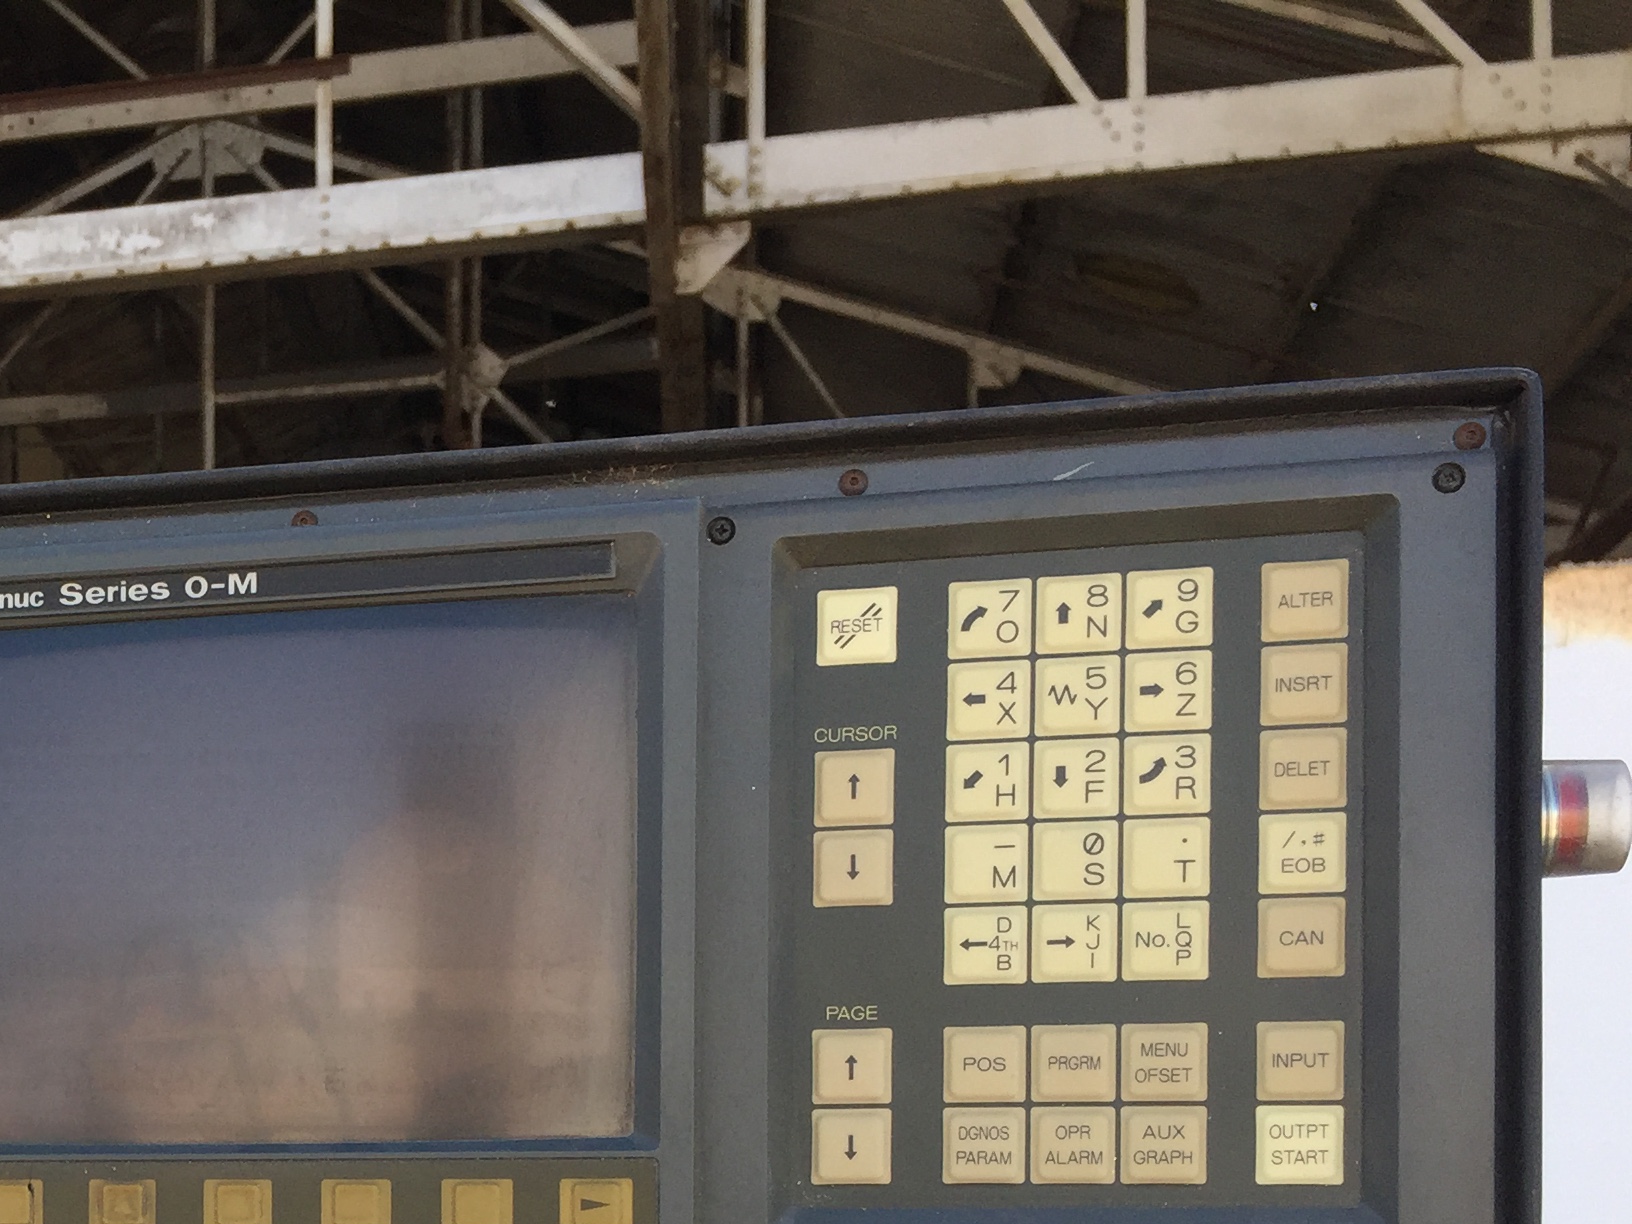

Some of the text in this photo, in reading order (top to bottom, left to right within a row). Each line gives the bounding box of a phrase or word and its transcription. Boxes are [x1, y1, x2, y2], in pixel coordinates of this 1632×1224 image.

[59, 579, 170, 606] Series
[1086, 584, 1109, 608] 8
[1176, 578, 1199, 603] 9
[1277, 591, 1334, 609] ALTER
[998, 589, 1021, 613] 7
[830, 617, 883, 635] RESET
[1086, 614, 1108, 639] N
[1175, 609, 1199, 635] G
[995, 671, 1018, 694] 4
[1085, 665, 1107, 690] 5
[1175, 660, 1198, 686] 6
[1274, 674, 1334, 695] INSRT
[996, 701, 1018, 726] X
[1084, 697, 1109, 721] Y
[1175, 692, 1198, 718] Z
[813, 725, 899, 744] CURSOR
[997, 753, 1011, 777] 1
[1084, 749, 1107, 773] 2
[1175, 744, 1197, 770] 3
[1273, 759, 1332, 779] DELET
[995, 782, 1016, 807] H
[1084, 779, 1106, 804] F
[1175, 775, 1197, 801] R
[1082, 862, 1106, 887] S
[1173, 857, 1197, 884] T
[1280, 856, 1327, 875] EOB
[991, 864, 1017, 889] M
[996, 916, 1013, 934] D
[1085, 914, 1101, 932] K
[1176, 912, 1192, 930] L
[1085, 933, 1100, 950] J
[1134, 931, 1171, 949] No.
[1174, 930, 1193, 949] Q
[1278, 929, 1325, 948] CAN
[996, 953, 1013, 972] B
[1174, 948, 1193, 967] P
[825, 1004, 879, 1022] PAGE
[1139, 1042, 1189, 1058] MENU
[962, 1056, 1007, 1073] POS
[1047, 1055, 1102, 1071] PRGRM
[1271, 1052, 1330, 1069] INPUT
[1134, 1067, 1193, 1084] OFSET
[957, 1124, 1011, 1141] DGNOS
[1054, 1124, 1092, 1141] OPR
[1140, 1124, 1186, 1141] AUX
[1268, 1123, 1330, 1140] OUTPT
[955, 1150, 1013, 1166] PARAM
[1044, 1149, 1104, 1166] ALARM
[1132, 1149, 1194, 1167] GRAPH
[1270, 1149, 1329, 1167] START
